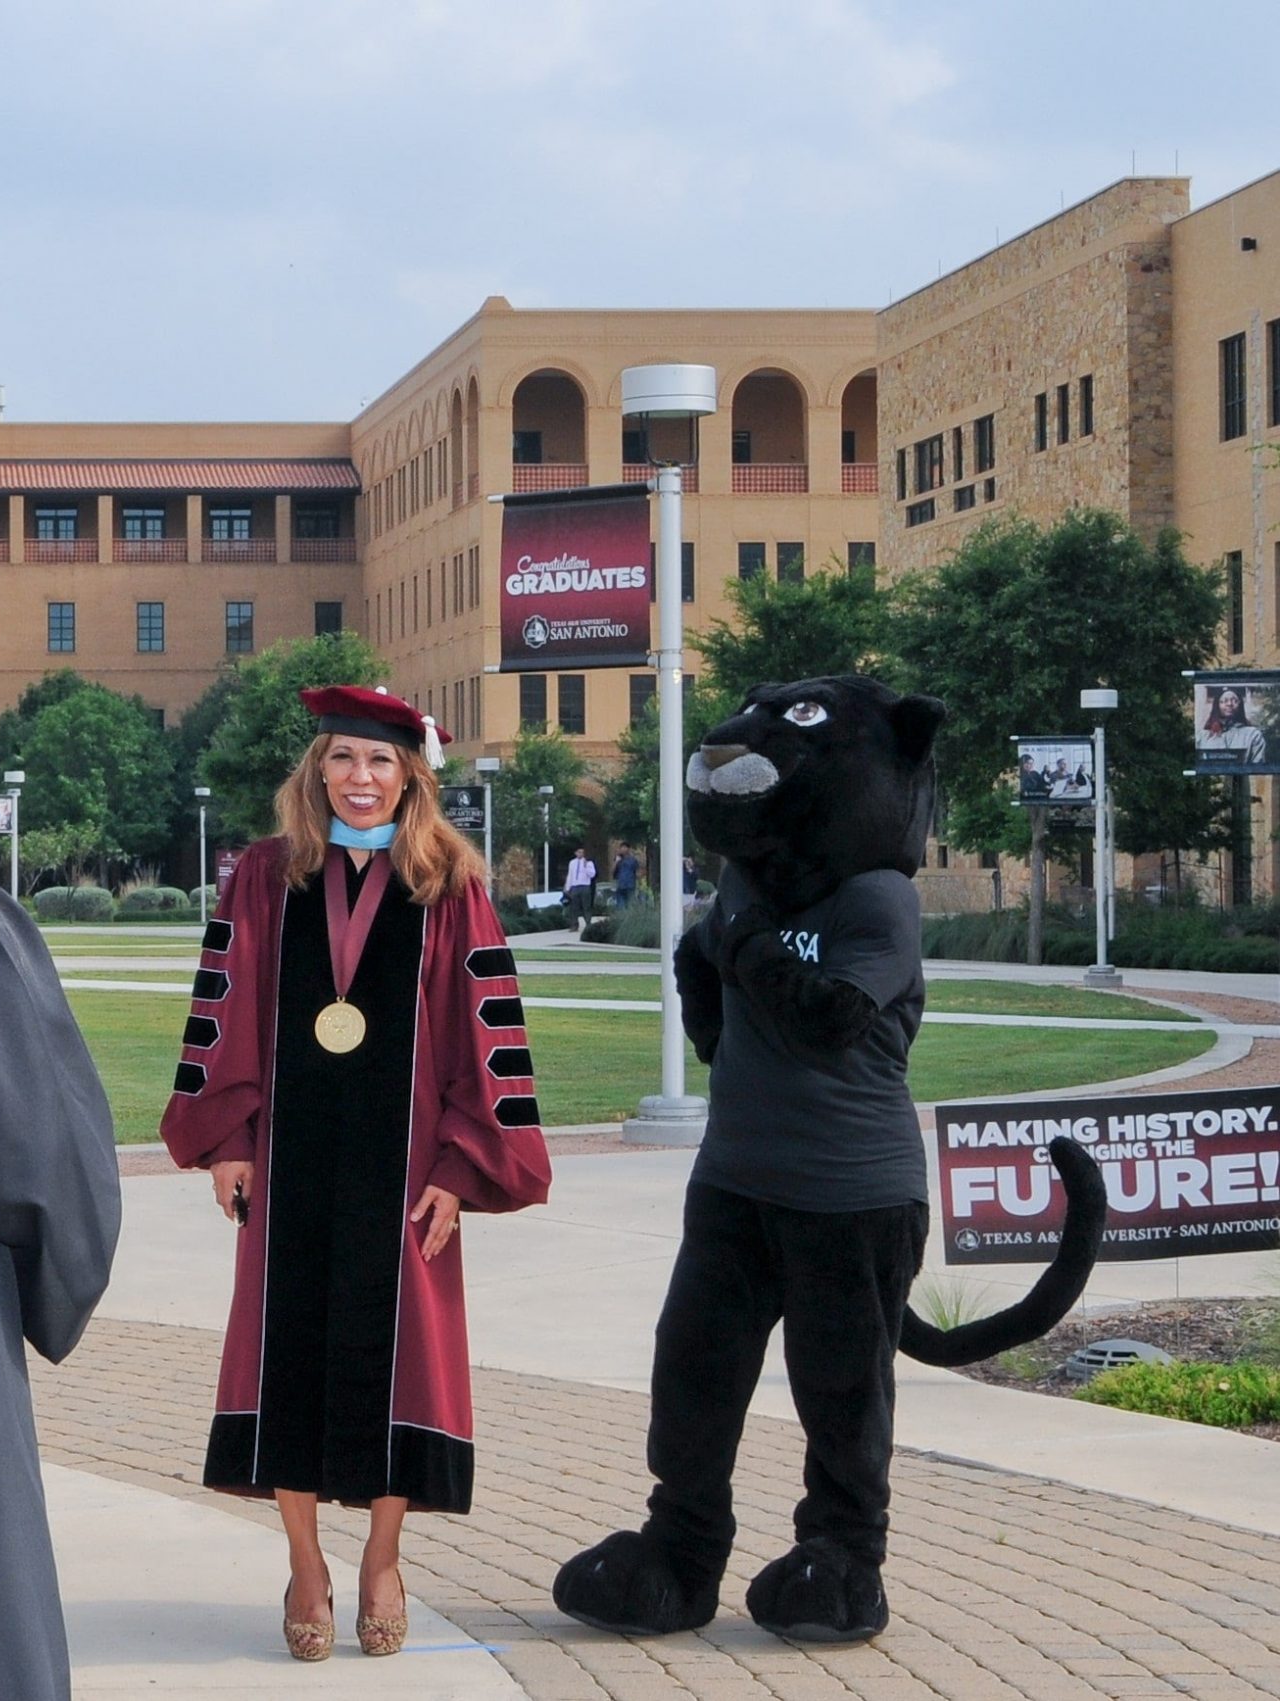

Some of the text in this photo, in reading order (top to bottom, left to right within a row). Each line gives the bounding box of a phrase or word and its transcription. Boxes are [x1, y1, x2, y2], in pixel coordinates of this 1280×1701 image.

[505, 566, 646, 596] GRADUATES
[550, 624, 629, 640] SAN ANTONIO
[947, 1106, 1277, 1148] MAKING HISTORY.
[1152, 1138, 1196, 1157] THE
[950, 1150, 1280, 1218] FUURE!
[982, 1231, 1033, 1245] TEXAS
[1037, 1230, 1063, 1243] A&
[1212, 1217, 1280, 1235] ANTONIO
